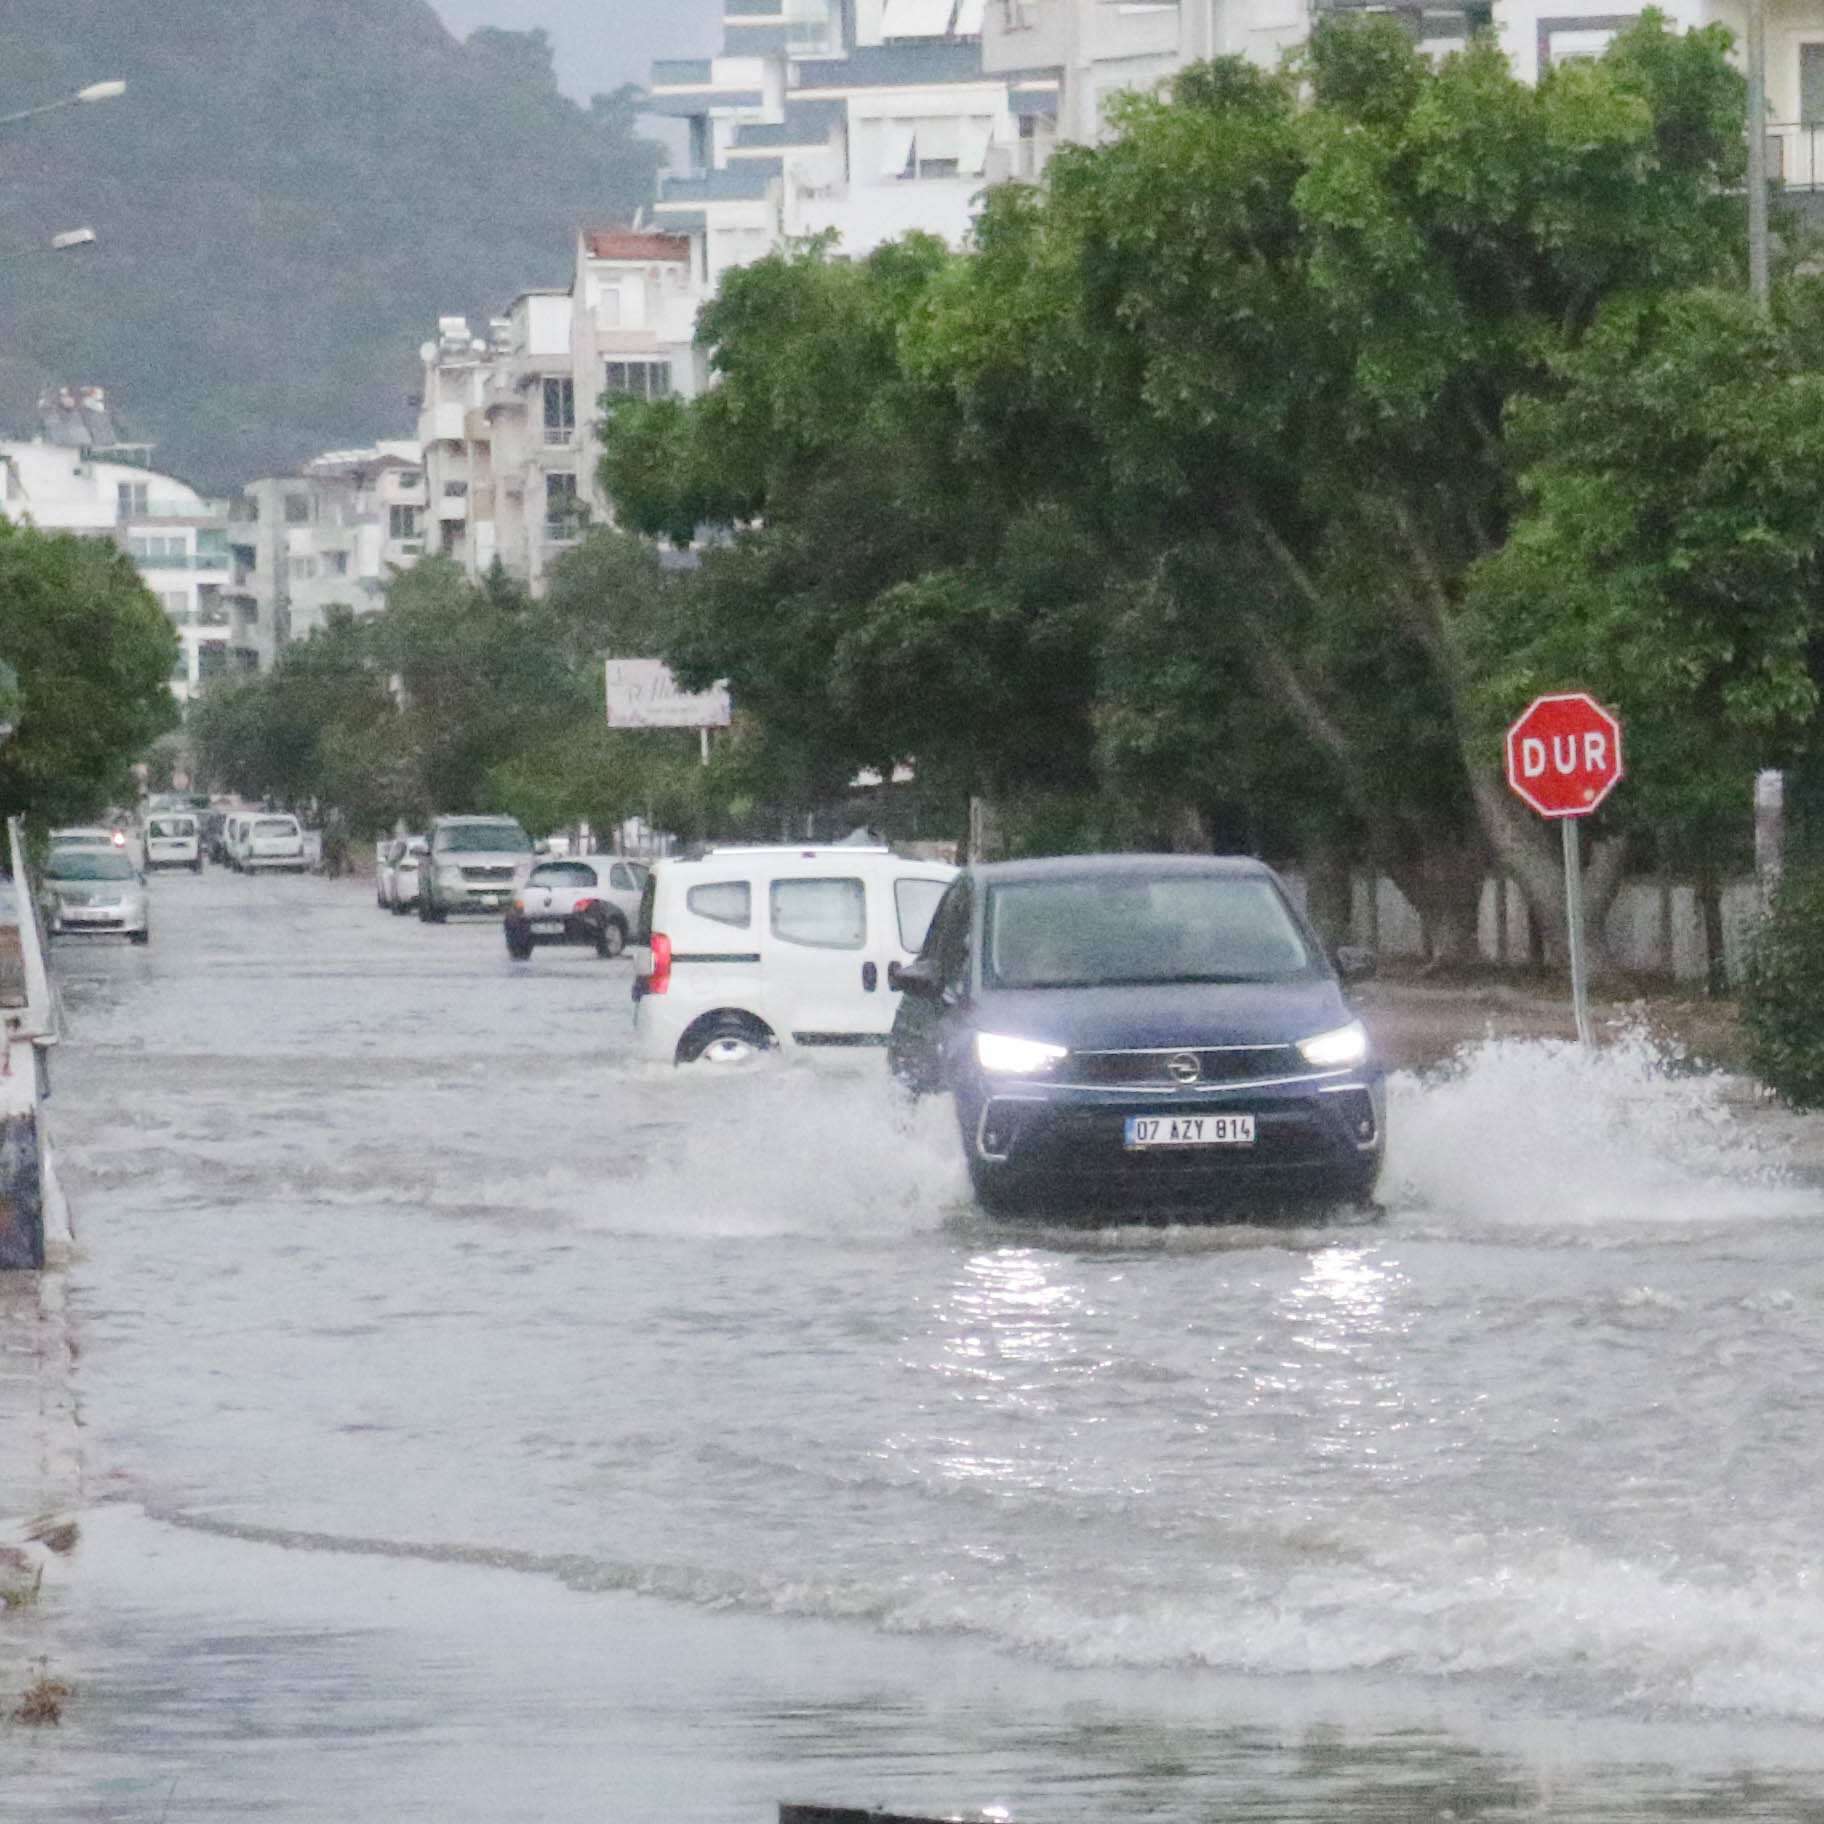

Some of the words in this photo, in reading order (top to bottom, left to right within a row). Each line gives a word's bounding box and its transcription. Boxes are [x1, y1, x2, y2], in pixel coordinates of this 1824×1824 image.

[1522, 732, 1607, 778] DUR
[1137, 1120, 1160, 1141] 07
[1170, 1119, 1204, 1140] AZY
[1216, 1118, 1251, 1139] 814
